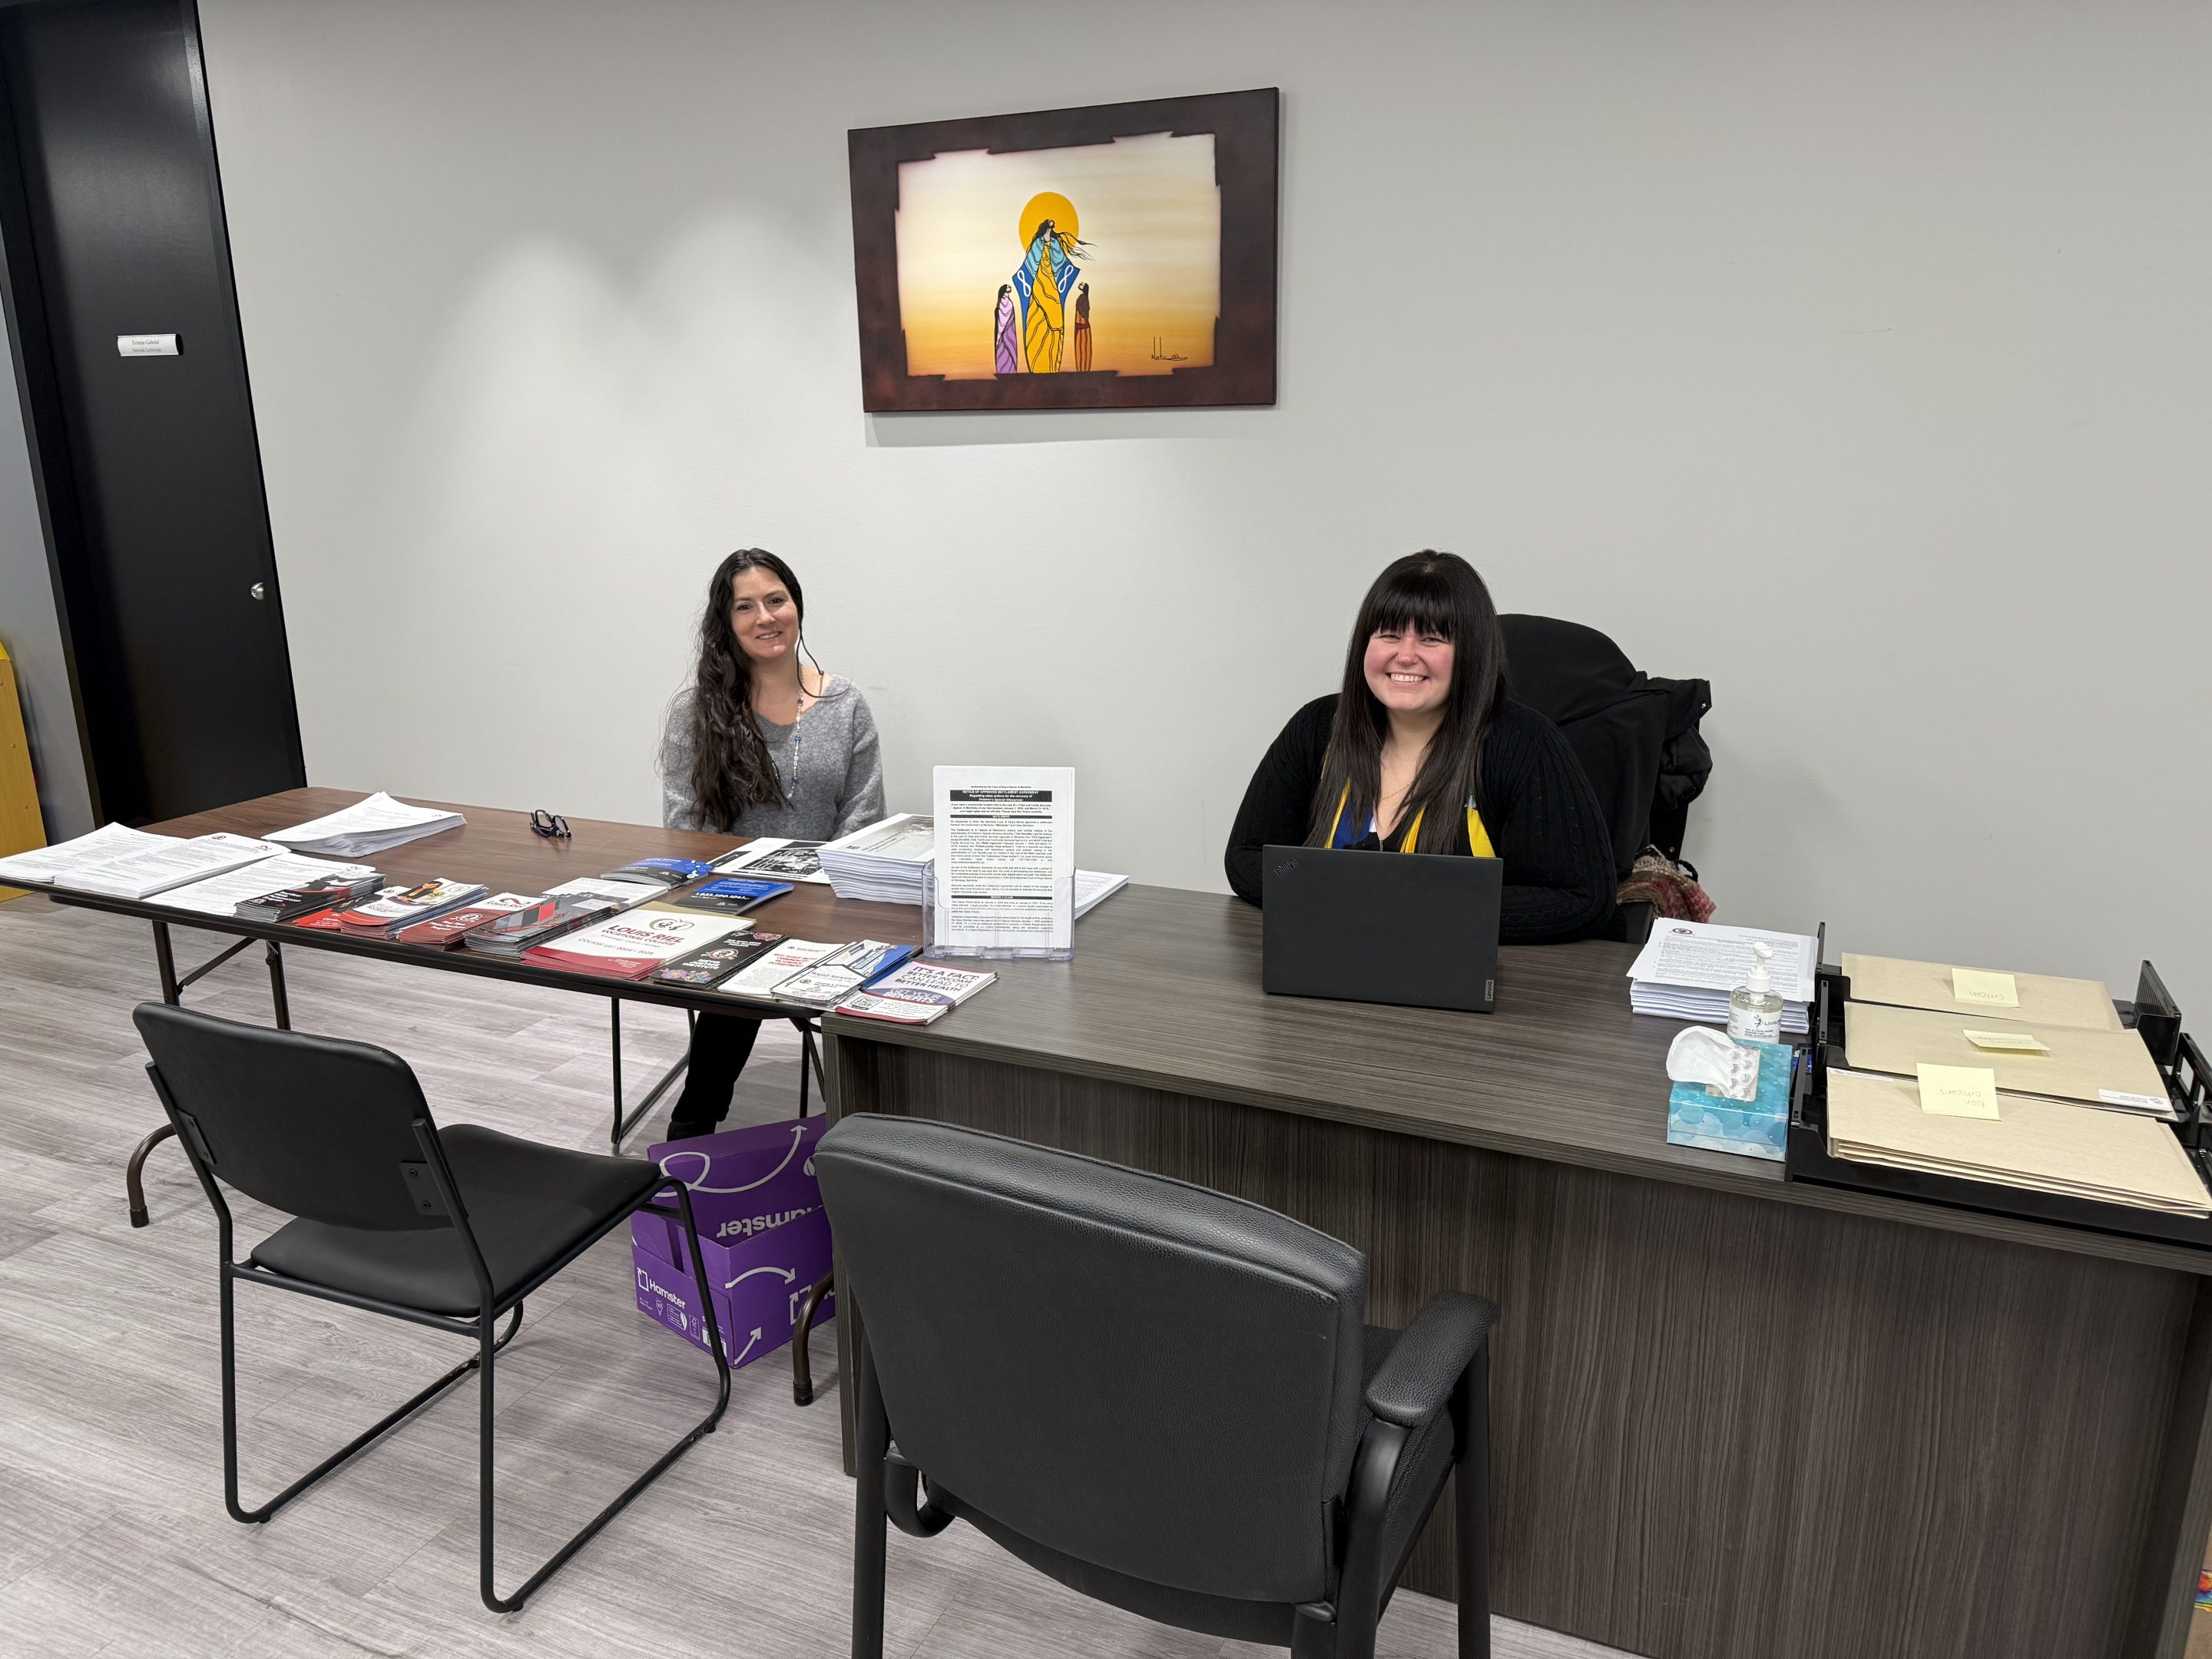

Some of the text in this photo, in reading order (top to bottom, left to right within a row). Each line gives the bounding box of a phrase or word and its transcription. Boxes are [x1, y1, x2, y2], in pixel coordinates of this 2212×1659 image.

[601, 929, 644, 941] VOCATIONAL
[608, 925, 654, 937] LOUIS
[651, 934, 684, 943] RIEL
[906, 971, 974, 984] BETTER INCOME
[895, 979, 962, 992] BETTER HEALTH
[883, 992, 938, 1004] BENEFITS
[913, 989, 942, 998] YOUR
[716, 1207, 813, 1238] amster
[649, 1279, 686, 1309] Hamster
